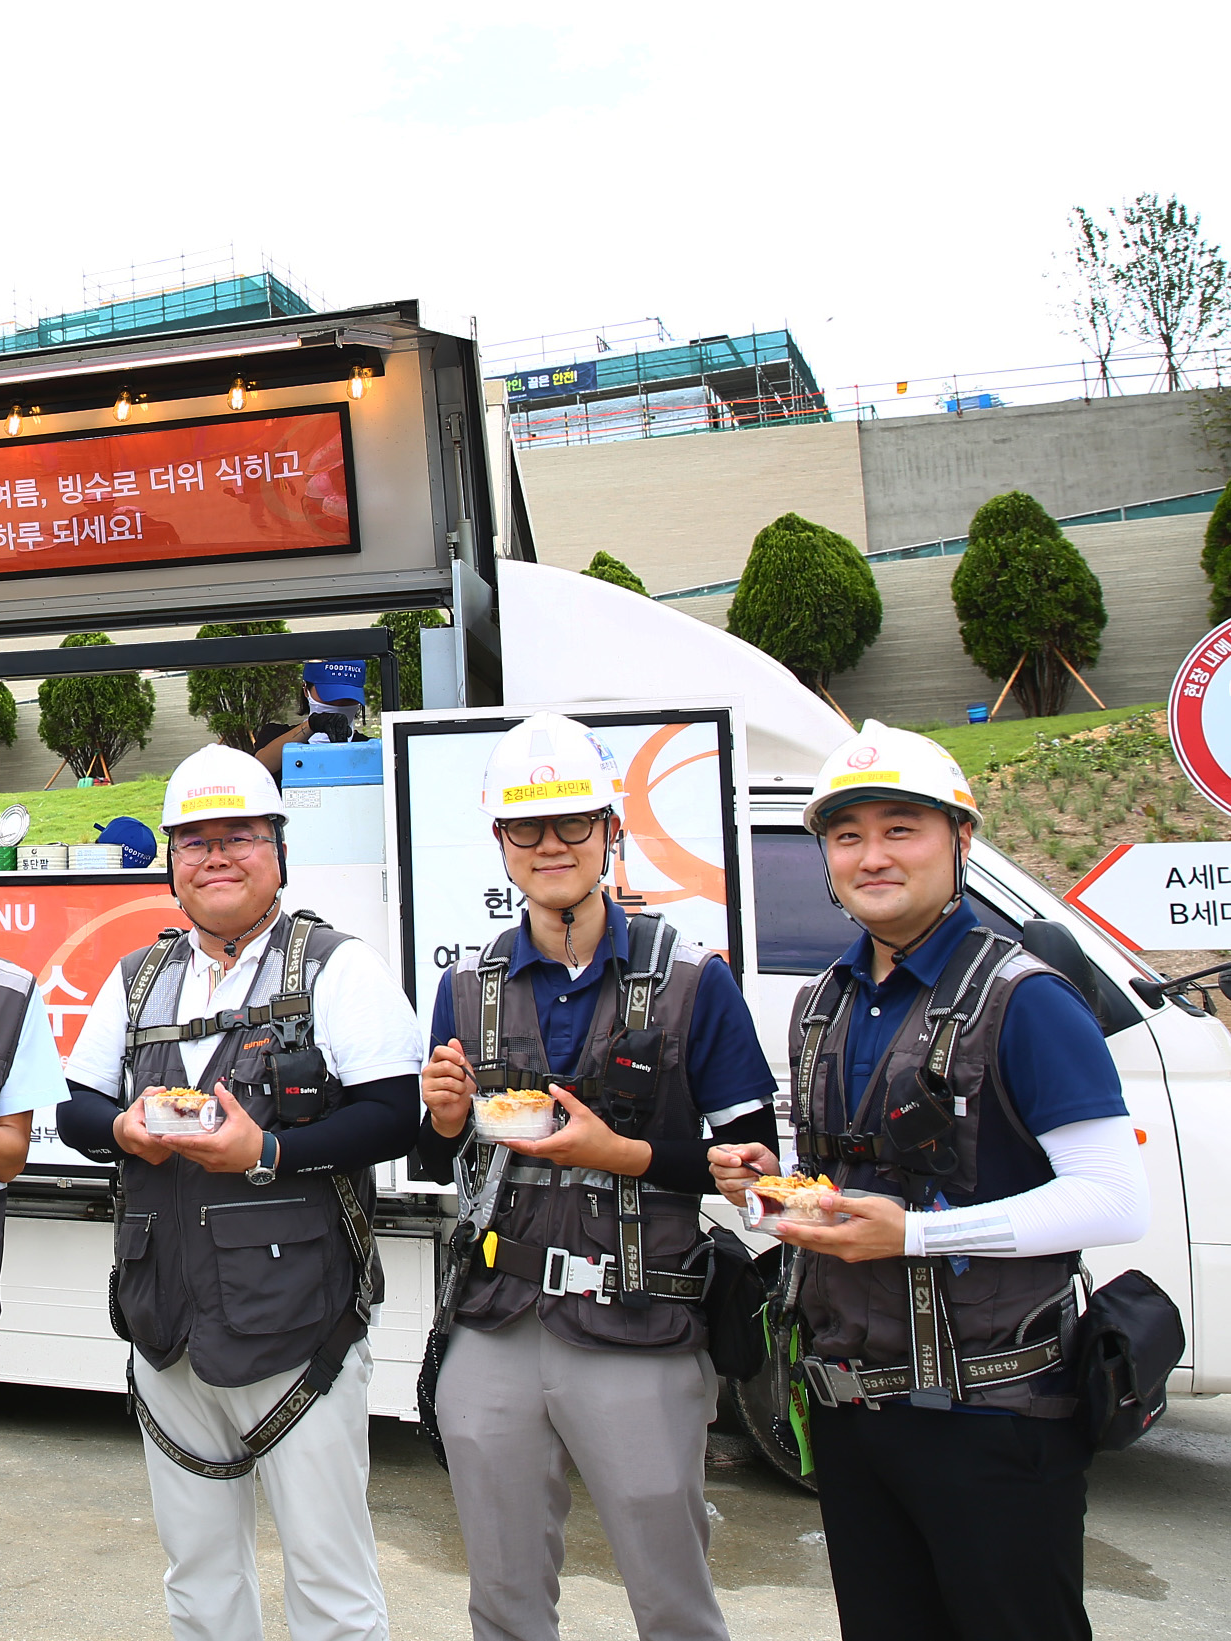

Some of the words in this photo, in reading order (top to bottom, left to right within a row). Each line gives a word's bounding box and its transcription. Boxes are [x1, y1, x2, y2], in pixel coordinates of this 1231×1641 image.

[59, 467, 141, 506] 빙수로
[149, 458, 205, 494] 더위
[215, 449, 304, 484] 식히고
[51, 510, 143, 546] 되세요!
[324, 663, 362, 674] FOODTRUCK
[1183, 667, 1210, 698] 현장
[504, 786, 548, 802] 조경대리
[21, 858, 49, 870] 통단팥
[121, 843, 152, 861] FOODTRUCK
[288, 937, 304, 974] Safety
[131, 963, 156, 1001] Safety
[484, 980, 498, 1006] K2
[630, 985, 648, 1012] K2
[631, 1061, 652, 1073] Safety
[300, 1087, 318, 1096] Safety
[915, 1286, 932, 1315] K2
[969, 1359, 1020, 1378] Safety
[287, 1387, 310, 1412] K2
[259, 1408, 292, 1441] Safety
